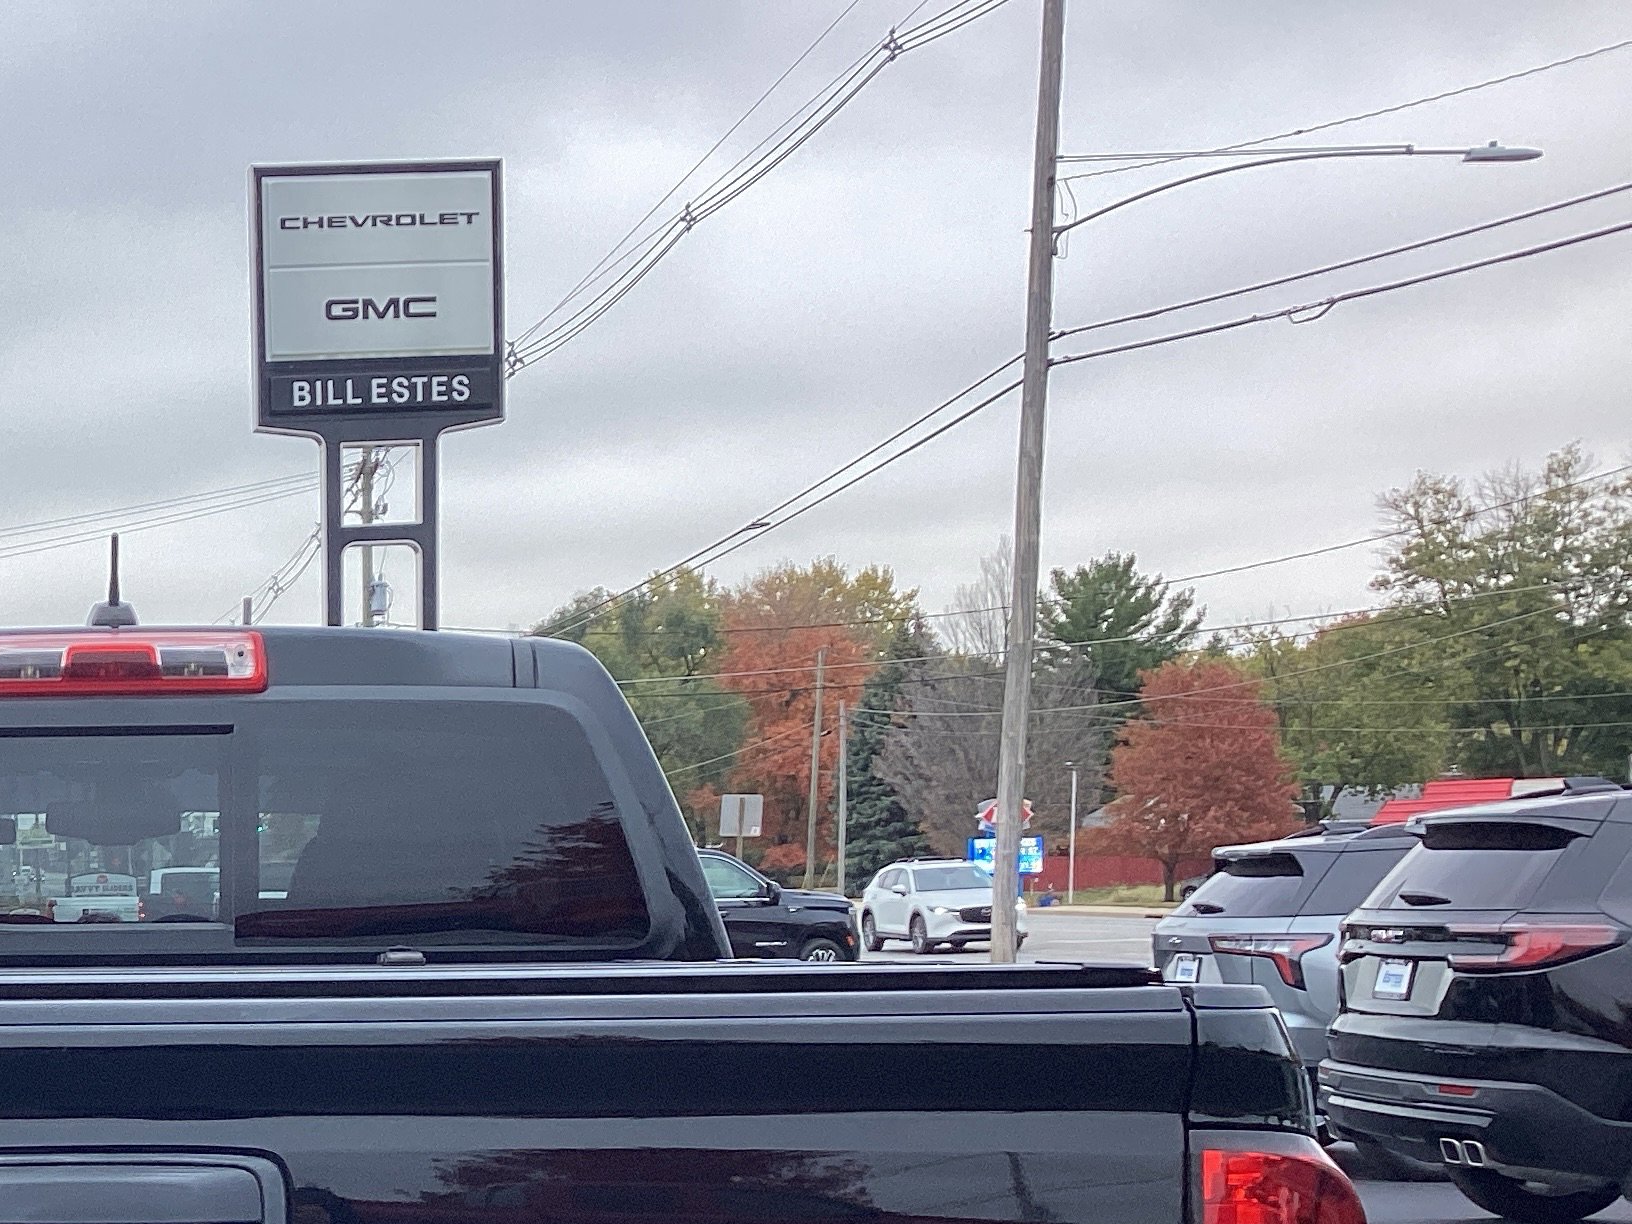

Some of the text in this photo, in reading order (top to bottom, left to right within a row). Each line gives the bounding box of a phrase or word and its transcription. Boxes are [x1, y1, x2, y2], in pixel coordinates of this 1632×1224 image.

[279, 211, 480, 230] CHEVROLET
[325, 296, 437, 320] GMC
[292, 375, 470, 407] BILL ESTES
